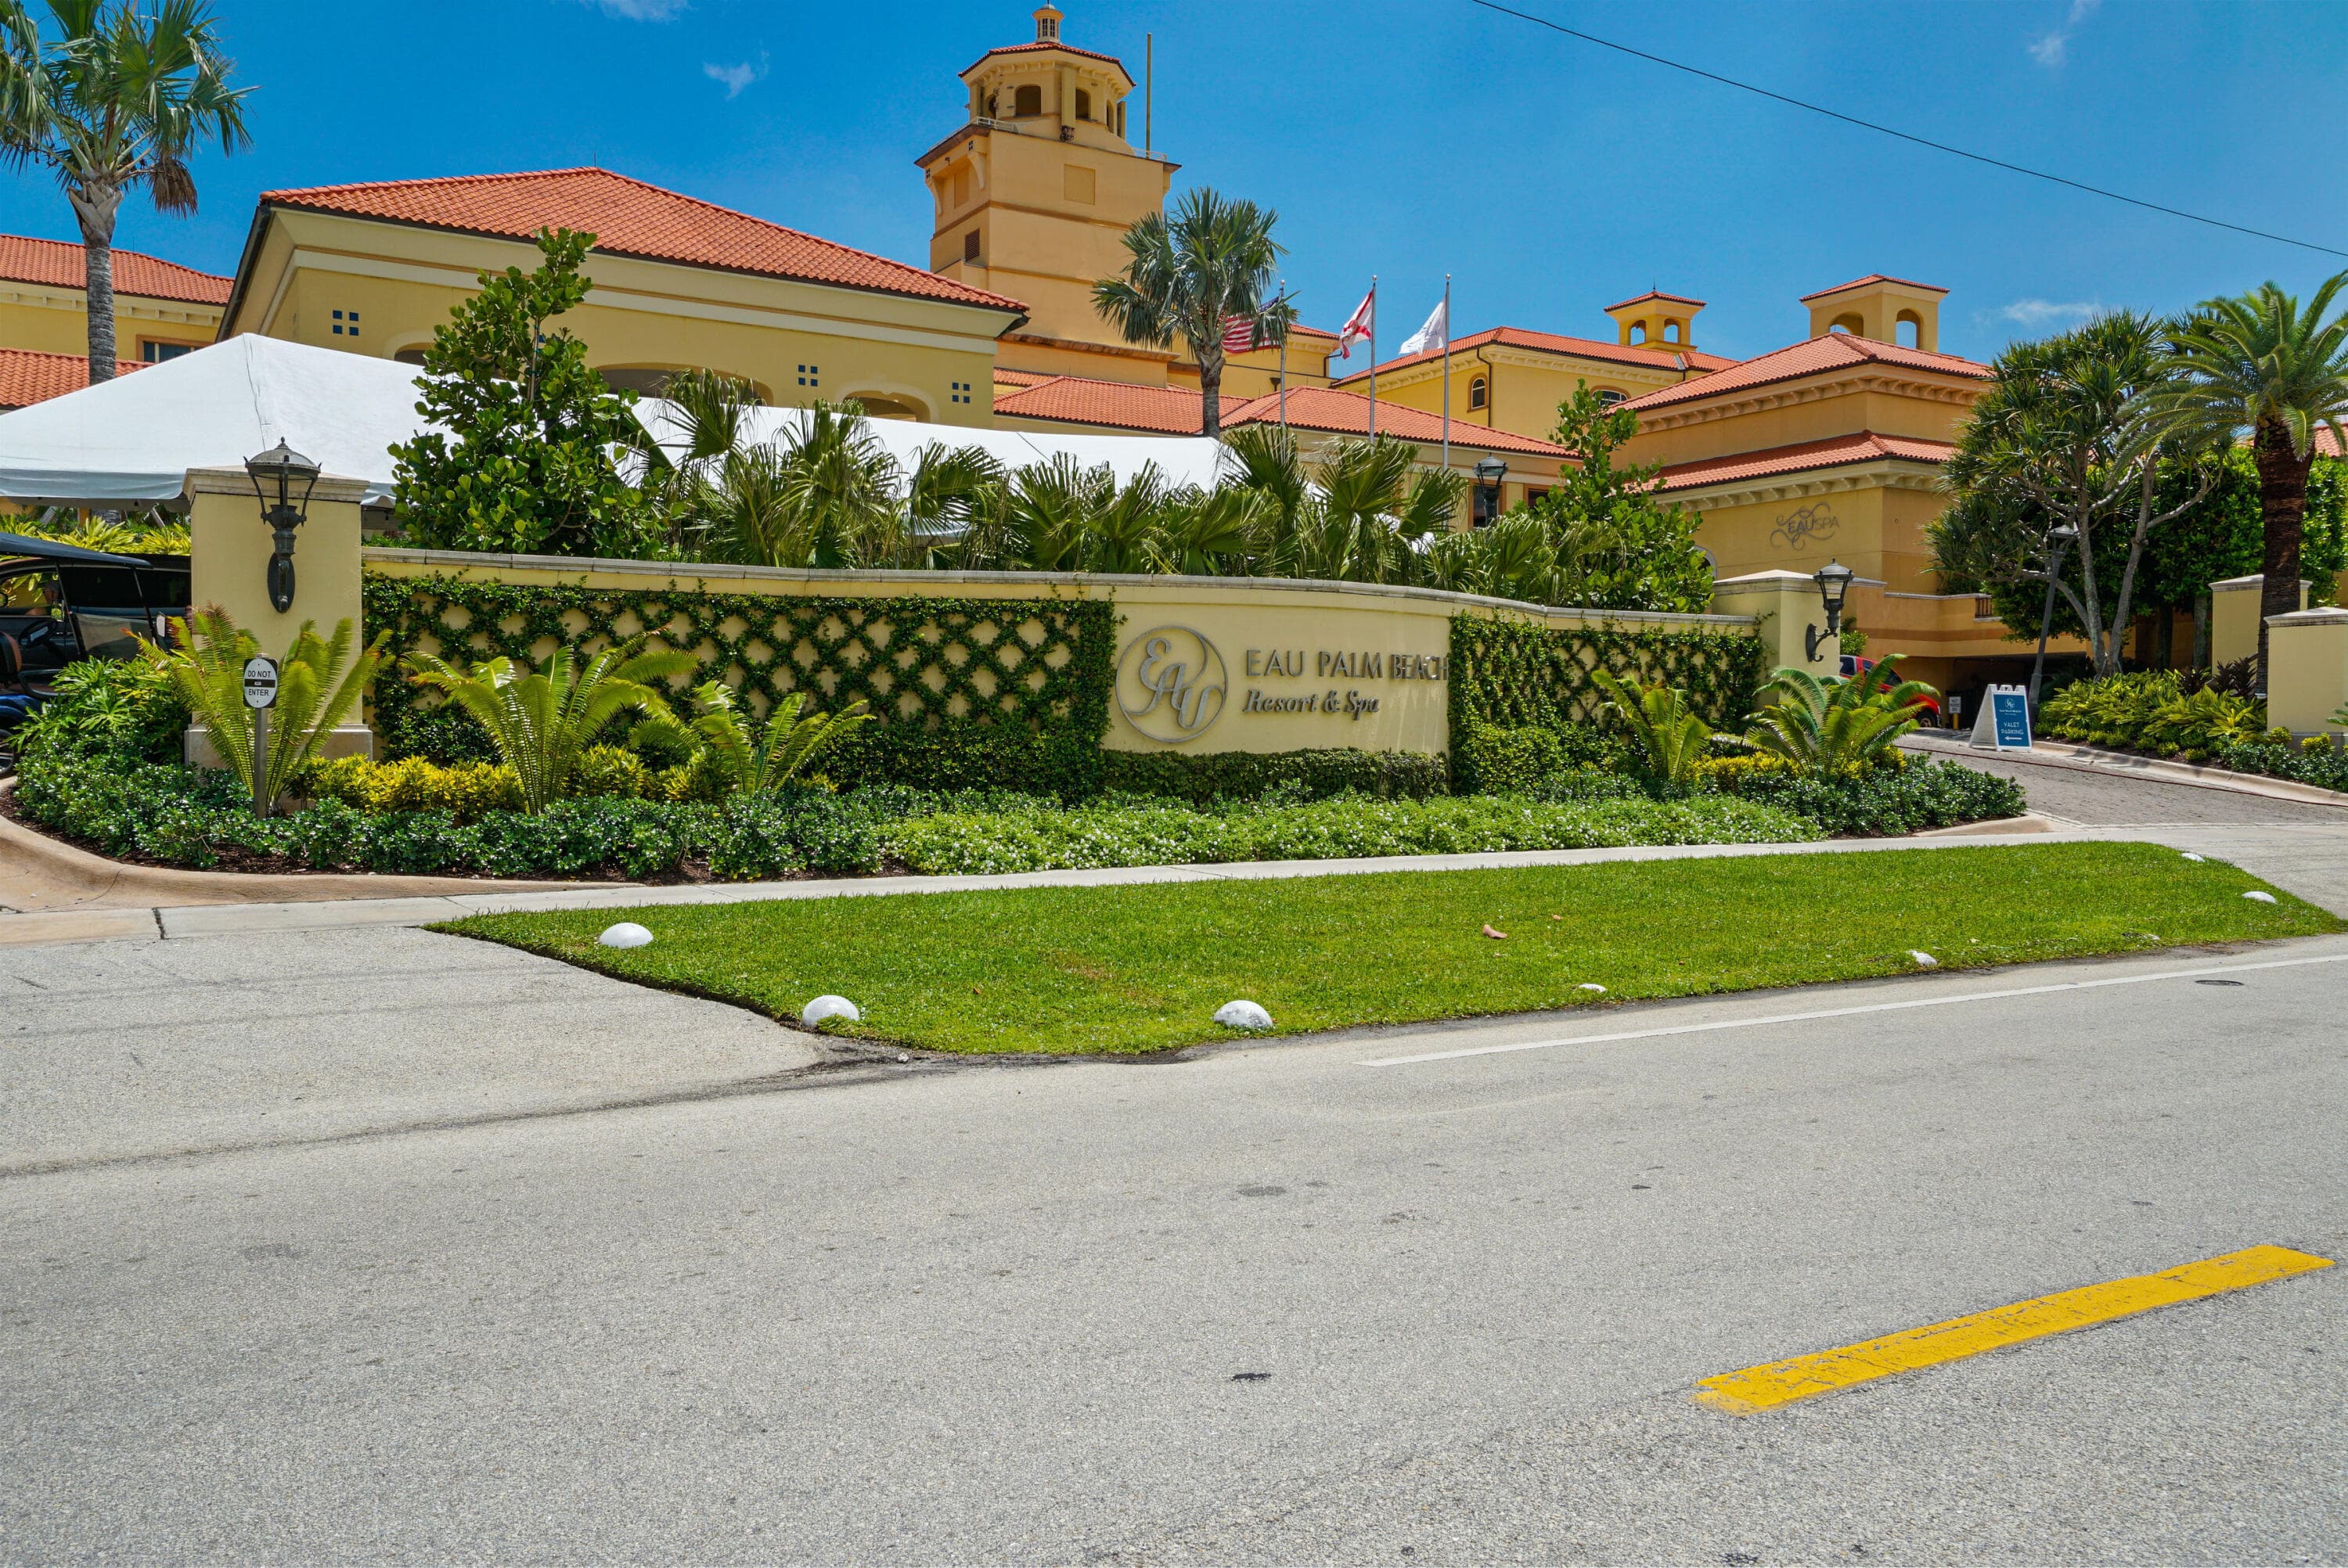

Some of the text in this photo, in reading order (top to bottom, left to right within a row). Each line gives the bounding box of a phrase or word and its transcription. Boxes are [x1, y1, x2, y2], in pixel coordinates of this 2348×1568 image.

[1788, 516, 1840, 533] EAU SPA
[1246, 649, 1448, 681] EAU PALM BEACH
[1242, 689, 1379, 721] Resort & Spa
